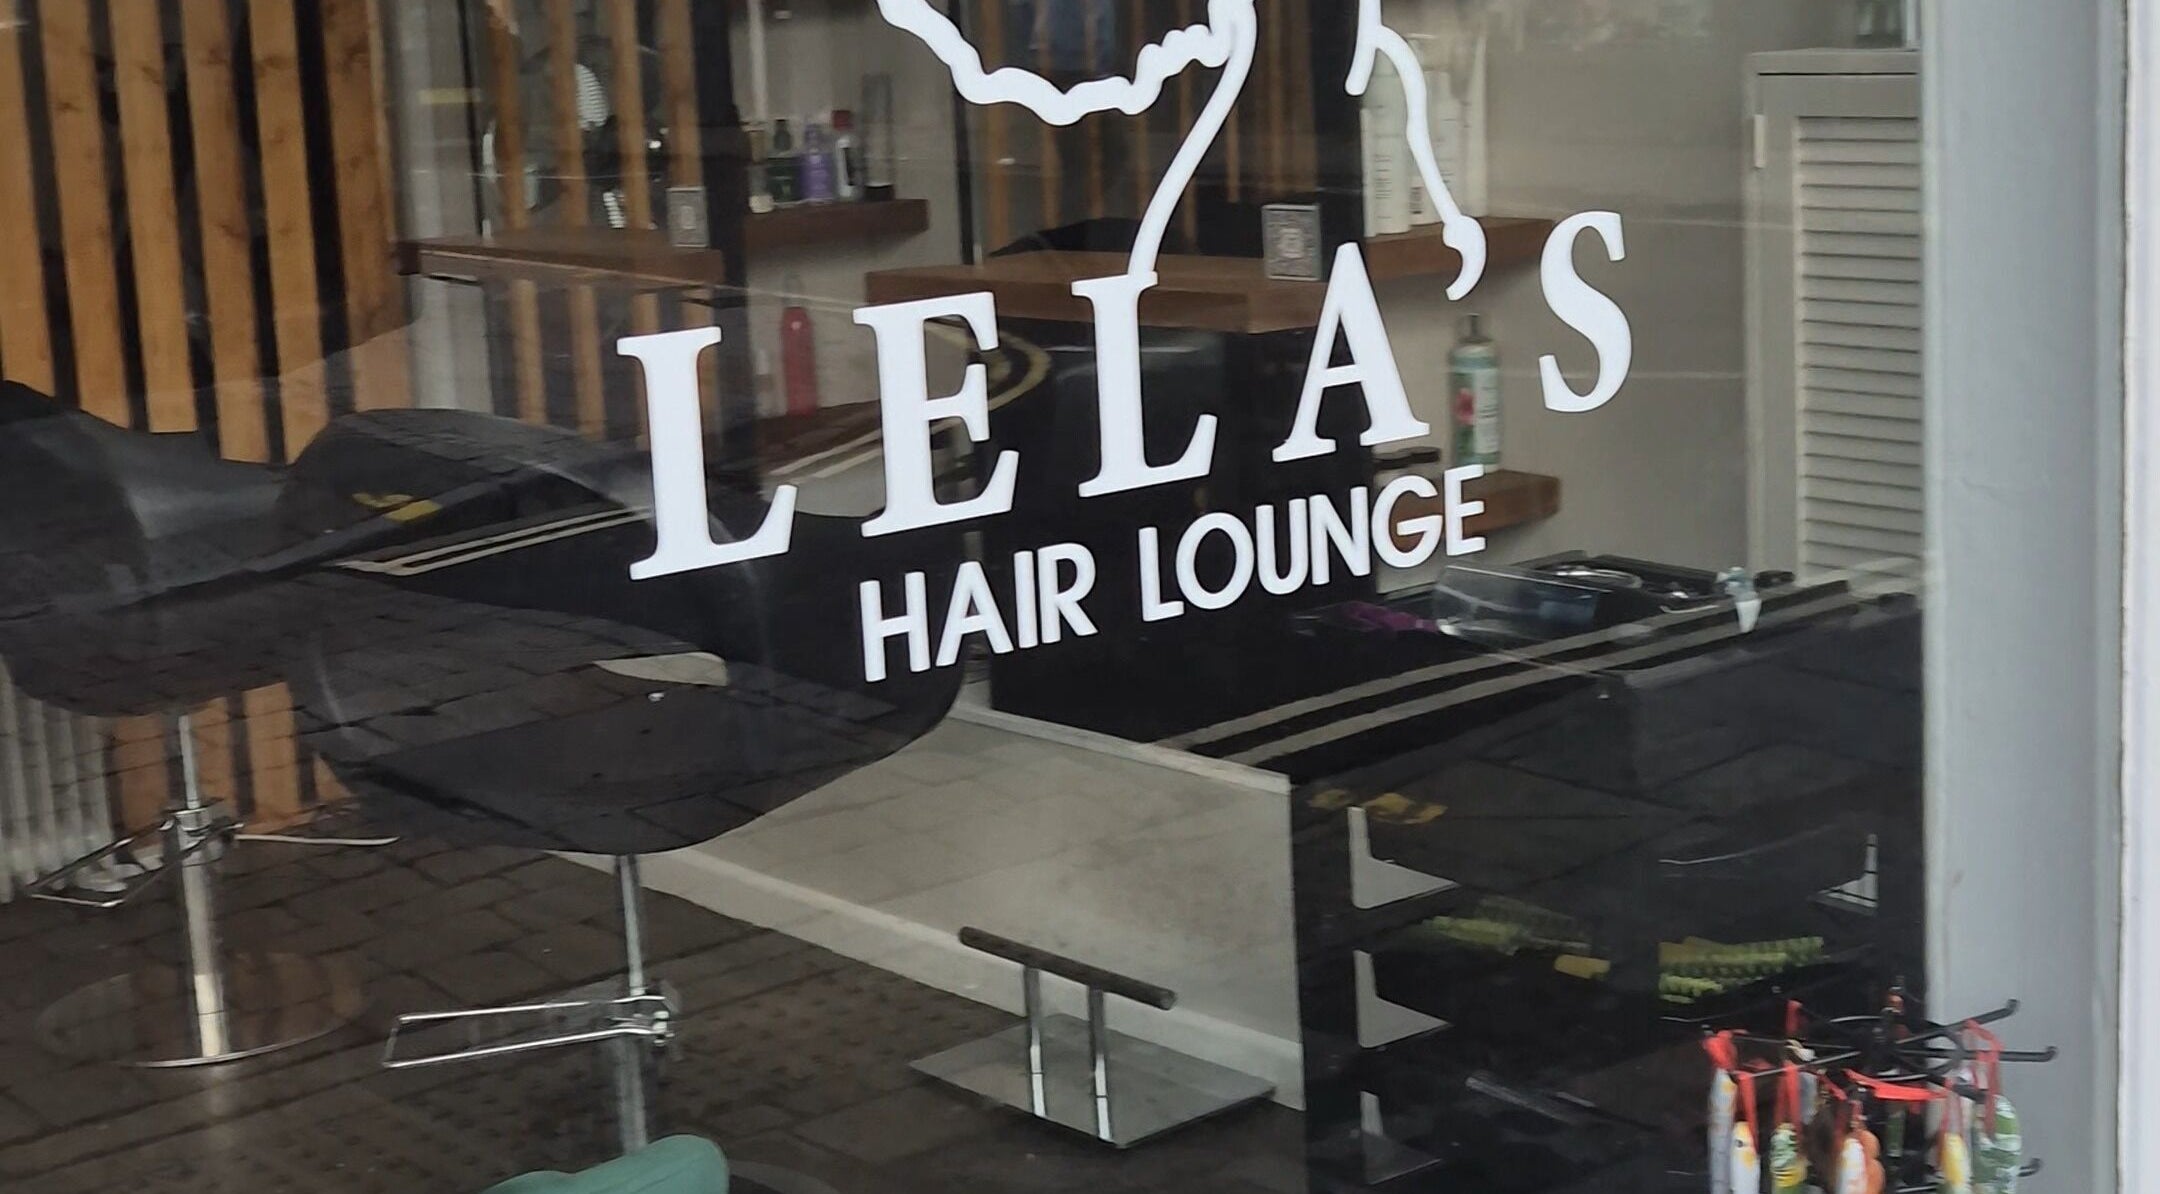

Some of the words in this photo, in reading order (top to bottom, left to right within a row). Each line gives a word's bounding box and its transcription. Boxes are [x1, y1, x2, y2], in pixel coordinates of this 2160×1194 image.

[616, 210, 1632, 581] LELA'S
[860, 543, 1098, 682] HAIR
[1139, 464, 1486, 622] LOUNGE
